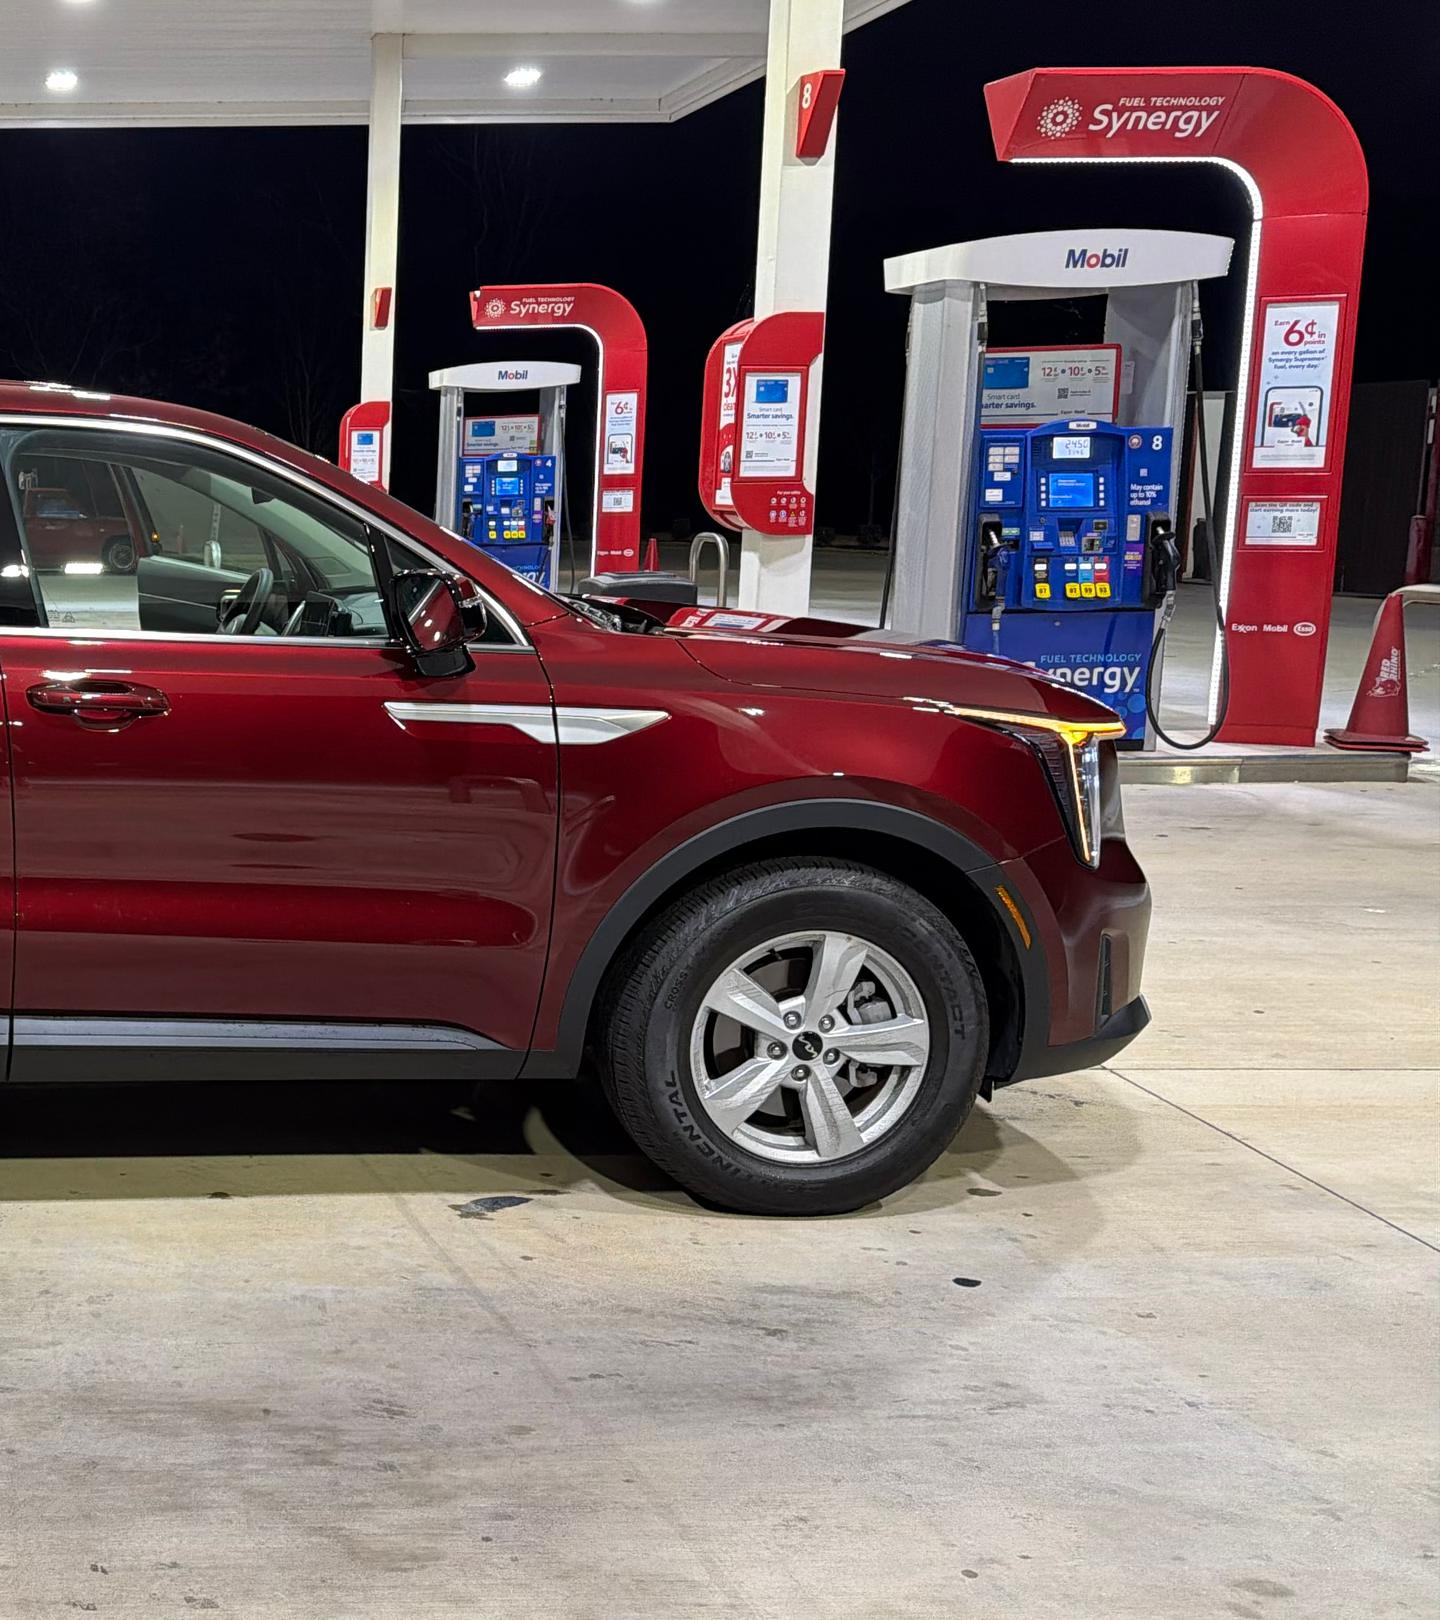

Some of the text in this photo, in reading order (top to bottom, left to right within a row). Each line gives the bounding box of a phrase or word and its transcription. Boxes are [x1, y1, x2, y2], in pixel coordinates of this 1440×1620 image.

[801, 82, 812, 109] 8
[1118, 96, 1226, 107] FUEL TECHNOLOGY
[1087, 102, 1221, 138] Synergy
[1064, 247, 1129, 270] Mobil
[509, 300, 574, 317] Synergy
[1317, 330, 1327, 338] in
[497, 369, 529, 381] Mobil
[1151, 434, 1163, 451] 8
[545, 458, 552, 468] 4
[1130, 483, 1164, 491] May contain
[1130, 491, 1138, 499] up
[1129, 498, 1152, 506] ethanol
[1231, 623, 1289, 633] Exxon Mobil
[1040, 653, 1142, 664] FUEL TECHNOLOGY
[1390, 647, 1399, 681] RHINO
[1379, 658, 1391, 682] RED
